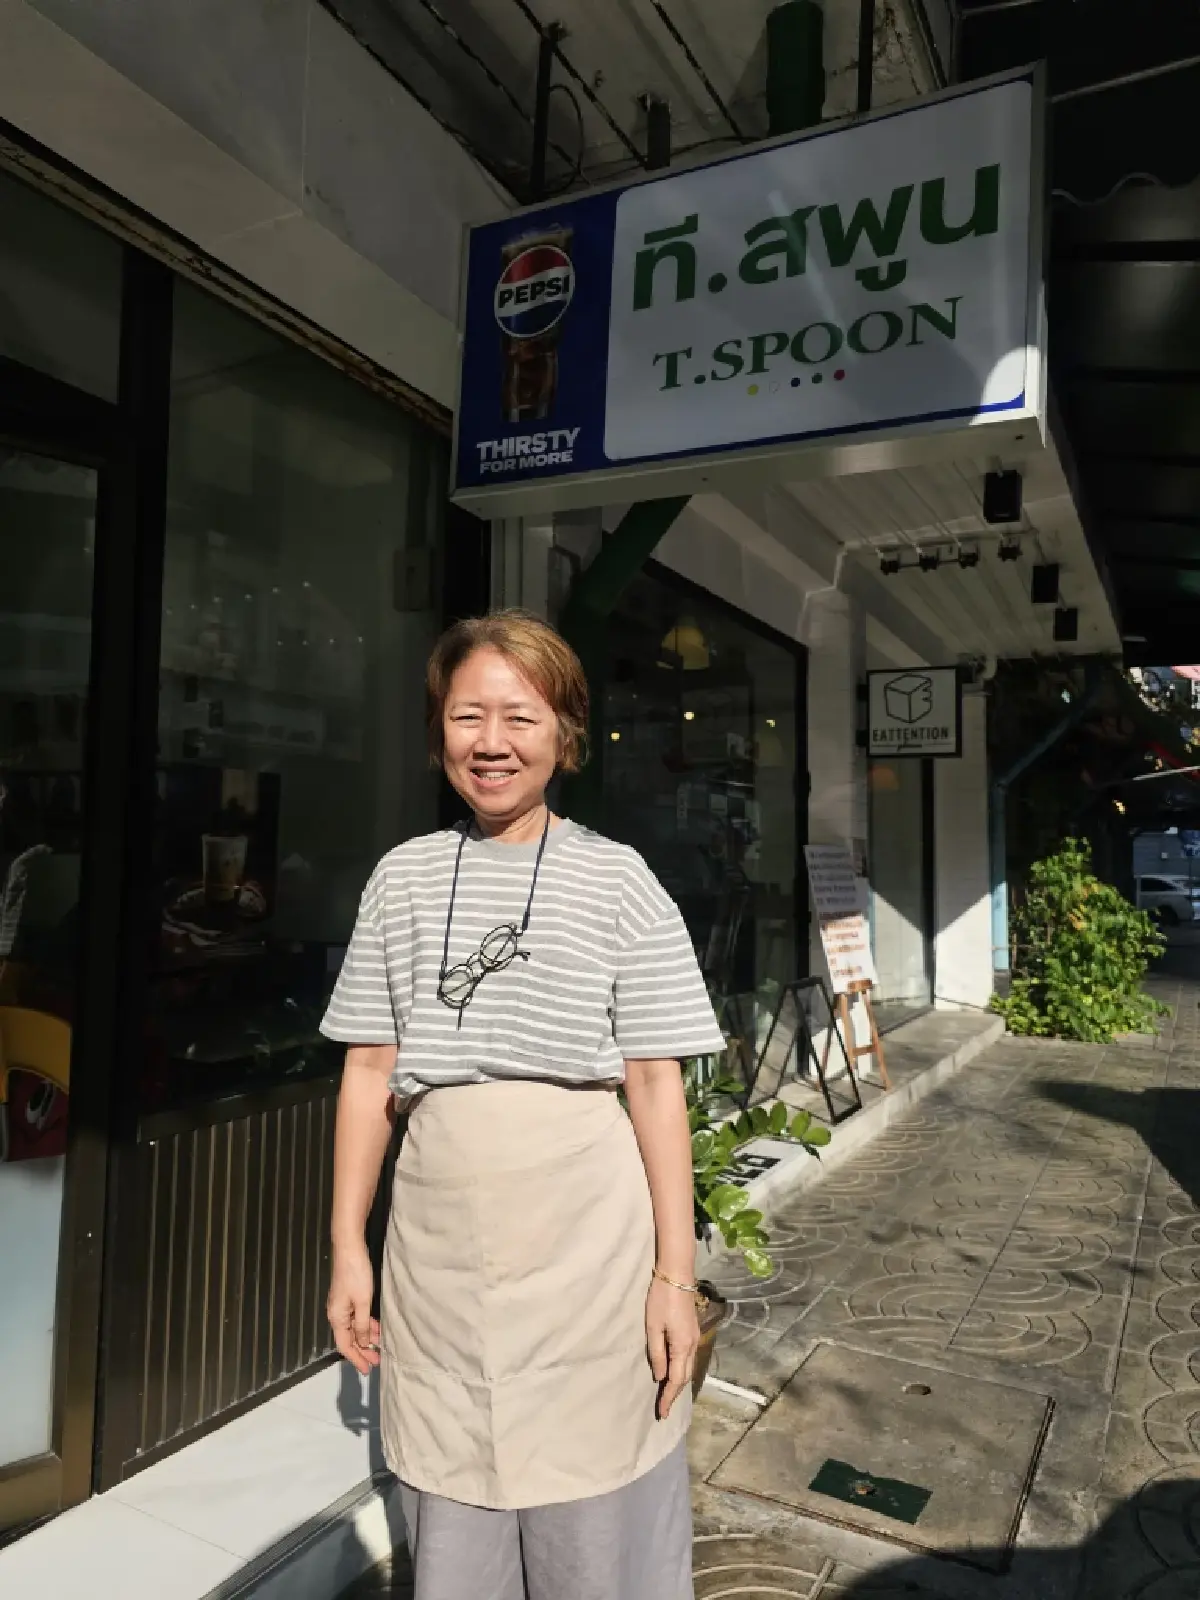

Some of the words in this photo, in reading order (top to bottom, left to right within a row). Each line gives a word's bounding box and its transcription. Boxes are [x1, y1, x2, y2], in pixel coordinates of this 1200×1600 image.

[633, 163, 1000, 312] ที.สพูน
[498, 274, 570, 309] PEPSI
[652, 296, 963, 392] T.SPOON
[476, 427, 580, 461] THIRSTY
[480, 460, 517, 475] FOR
[518, 451, 573, 470] MORE
[872, 727, 949, 742] EATTENTION
